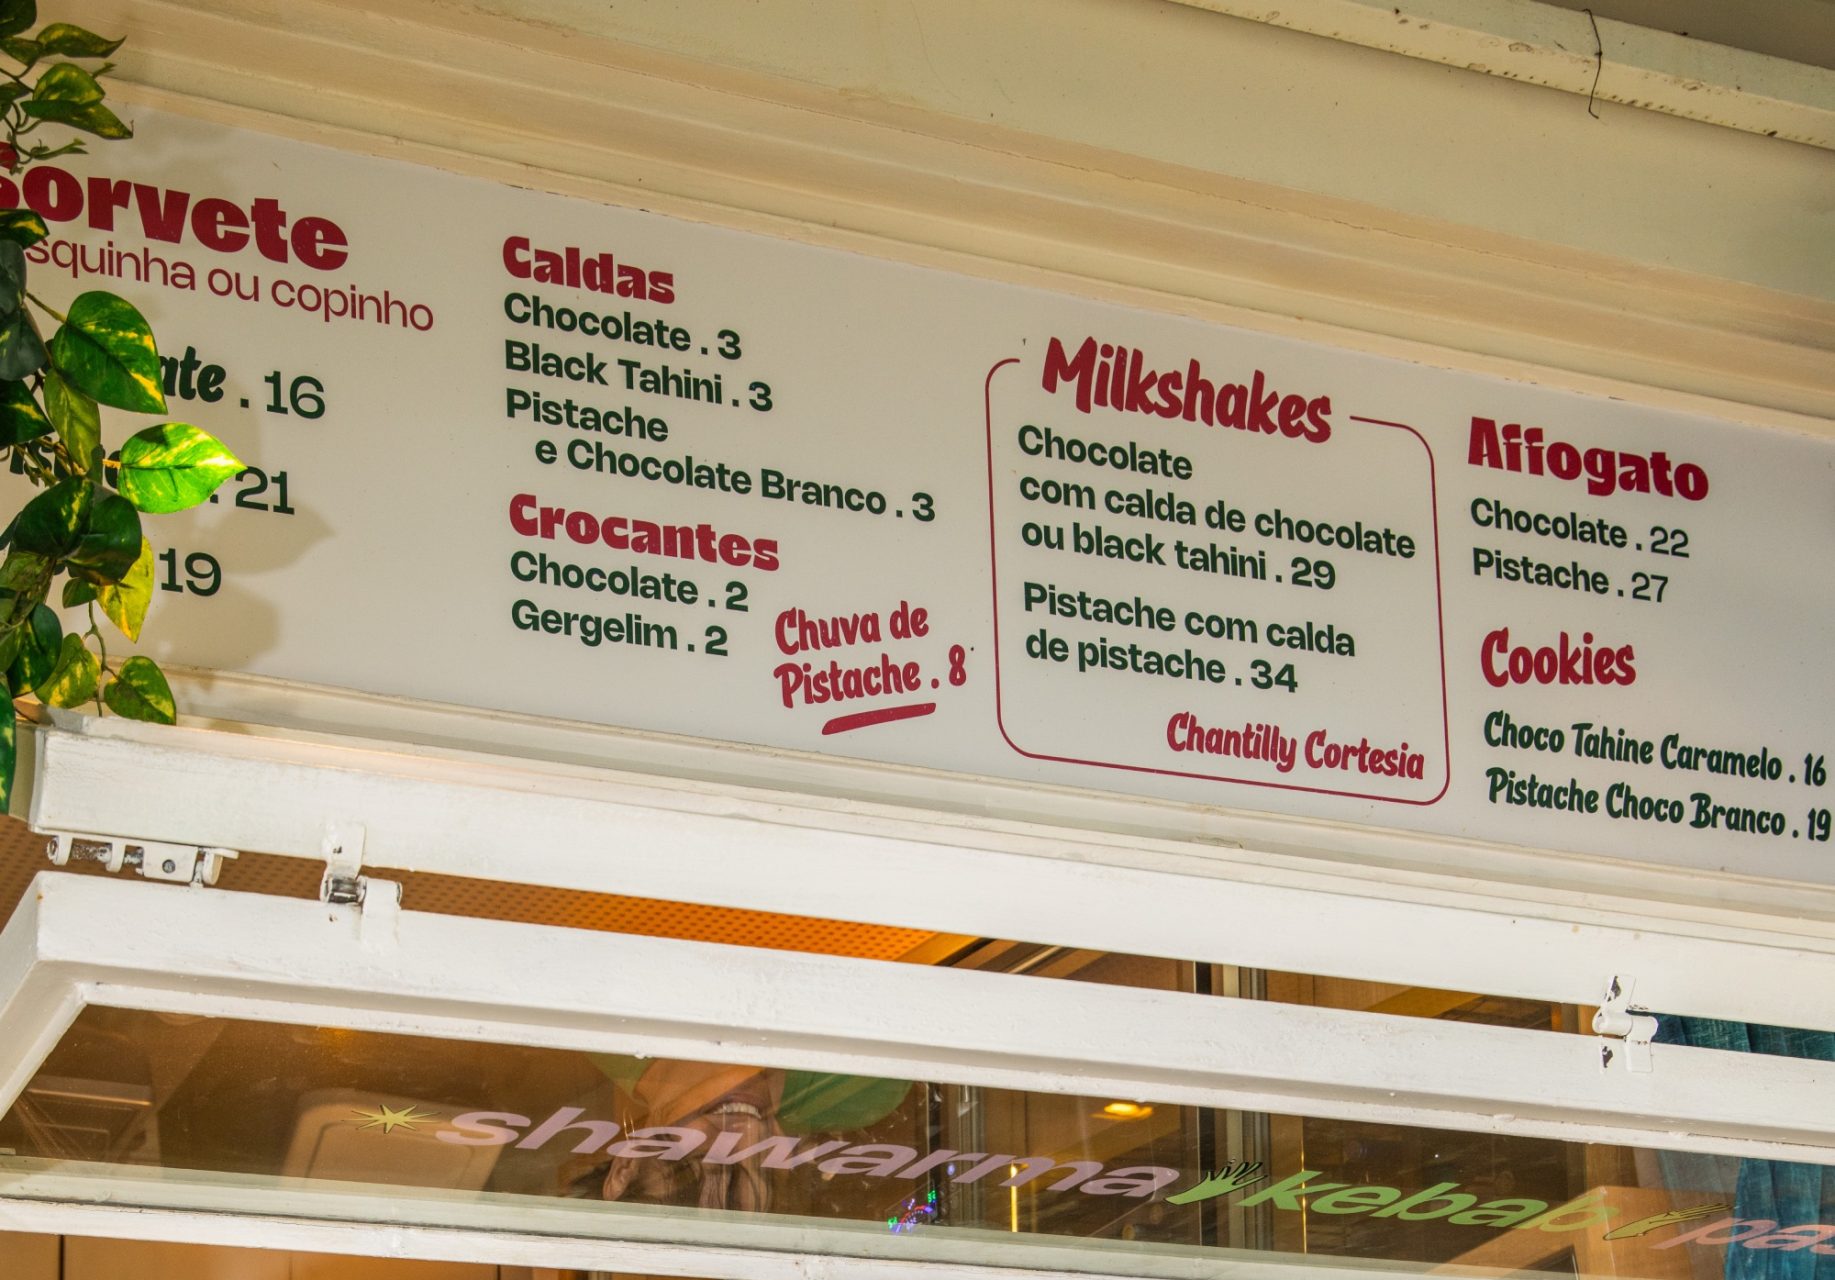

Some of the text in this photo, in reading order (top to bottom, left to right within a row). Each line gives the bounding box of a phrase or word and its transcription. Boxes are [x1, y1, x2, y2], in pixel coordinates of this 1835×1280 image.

[26, 240, 433, 331] squinha ou copinho
[503, 236, 674, 304] Caldas
[504, 293, 690, 351] Chocolate
[718, 330, 741, 360] 3
[265, 371, 325, 419] 16
[505, 340, 608, 385] Black
[618, 359, 722, 404] Tahini
[749, 382, 772, 411] 3
[1042, 337, 1331, 443] Milkshakes
[507, 388, 668, 442] Pistache
[536, 440, 557, 464] e
[567, 439, 751, 494] Chocolate
[761, 469, 886, 514] Branco
[912, 492, 935, 522] 3
[1018, 425, 1192, 480] Chocolate
[1468, 417, 1708, 501] Affogato
[235, 466, 294, 515] 21
[1020, 477, 1415, 558] com calda de chocolate
[510, 494, 779, 571] Crocantes
[1022, 523, 1064, 550] ou
[1073, 522, 1166, 565] black
[1174, 541, 1266, 580] tahini
[1291, 557, 1335, 589] 29
[1471, 498, 1627, 548] Chocolate
[1650, 526, 1689, 558] 22
[159, 548, 221, 596] 19
[511, 551, 698, 604] Chocolate
[726, 581, 748, 612] 2
[1473, 548, 1609, 594] Pistache
[1632, 572, 1668, 602] 27
[512, 599, 677, 650] Gergelim
[705, 626, 728, 656] 2
[775, 601, 929, 655] Chuva de
[1024, 582, 1355, 656] Pistache com calda
[774, 654, 921, 708] Pistache
[949, 645, 966, 686] 8
[1026, 629, 1068, 662] de
[1078, 637, 1225, 683] pistache
[1251, 660, 1298, 693] 34
[1481, 627, 1636, 687] Cookies
[1167, 712, 1424, 779] Chantilly Cortesia
[1484, 710, 1564, 753] Choco
[1571, 723, 1653, 764] Tahine
[1661, 733, 1782, 780] Caramelo
[1805, 753, 1826, 786] 16
[1486, 767, 1599, 813] Pistache
[1606, 782, 1684, 823] Choco
[1690, 793, 1785, 835] Branco
[1808, 808, 1831, 841] 19
[436, 1106, 1835, 1255] shawarma kebab pa
